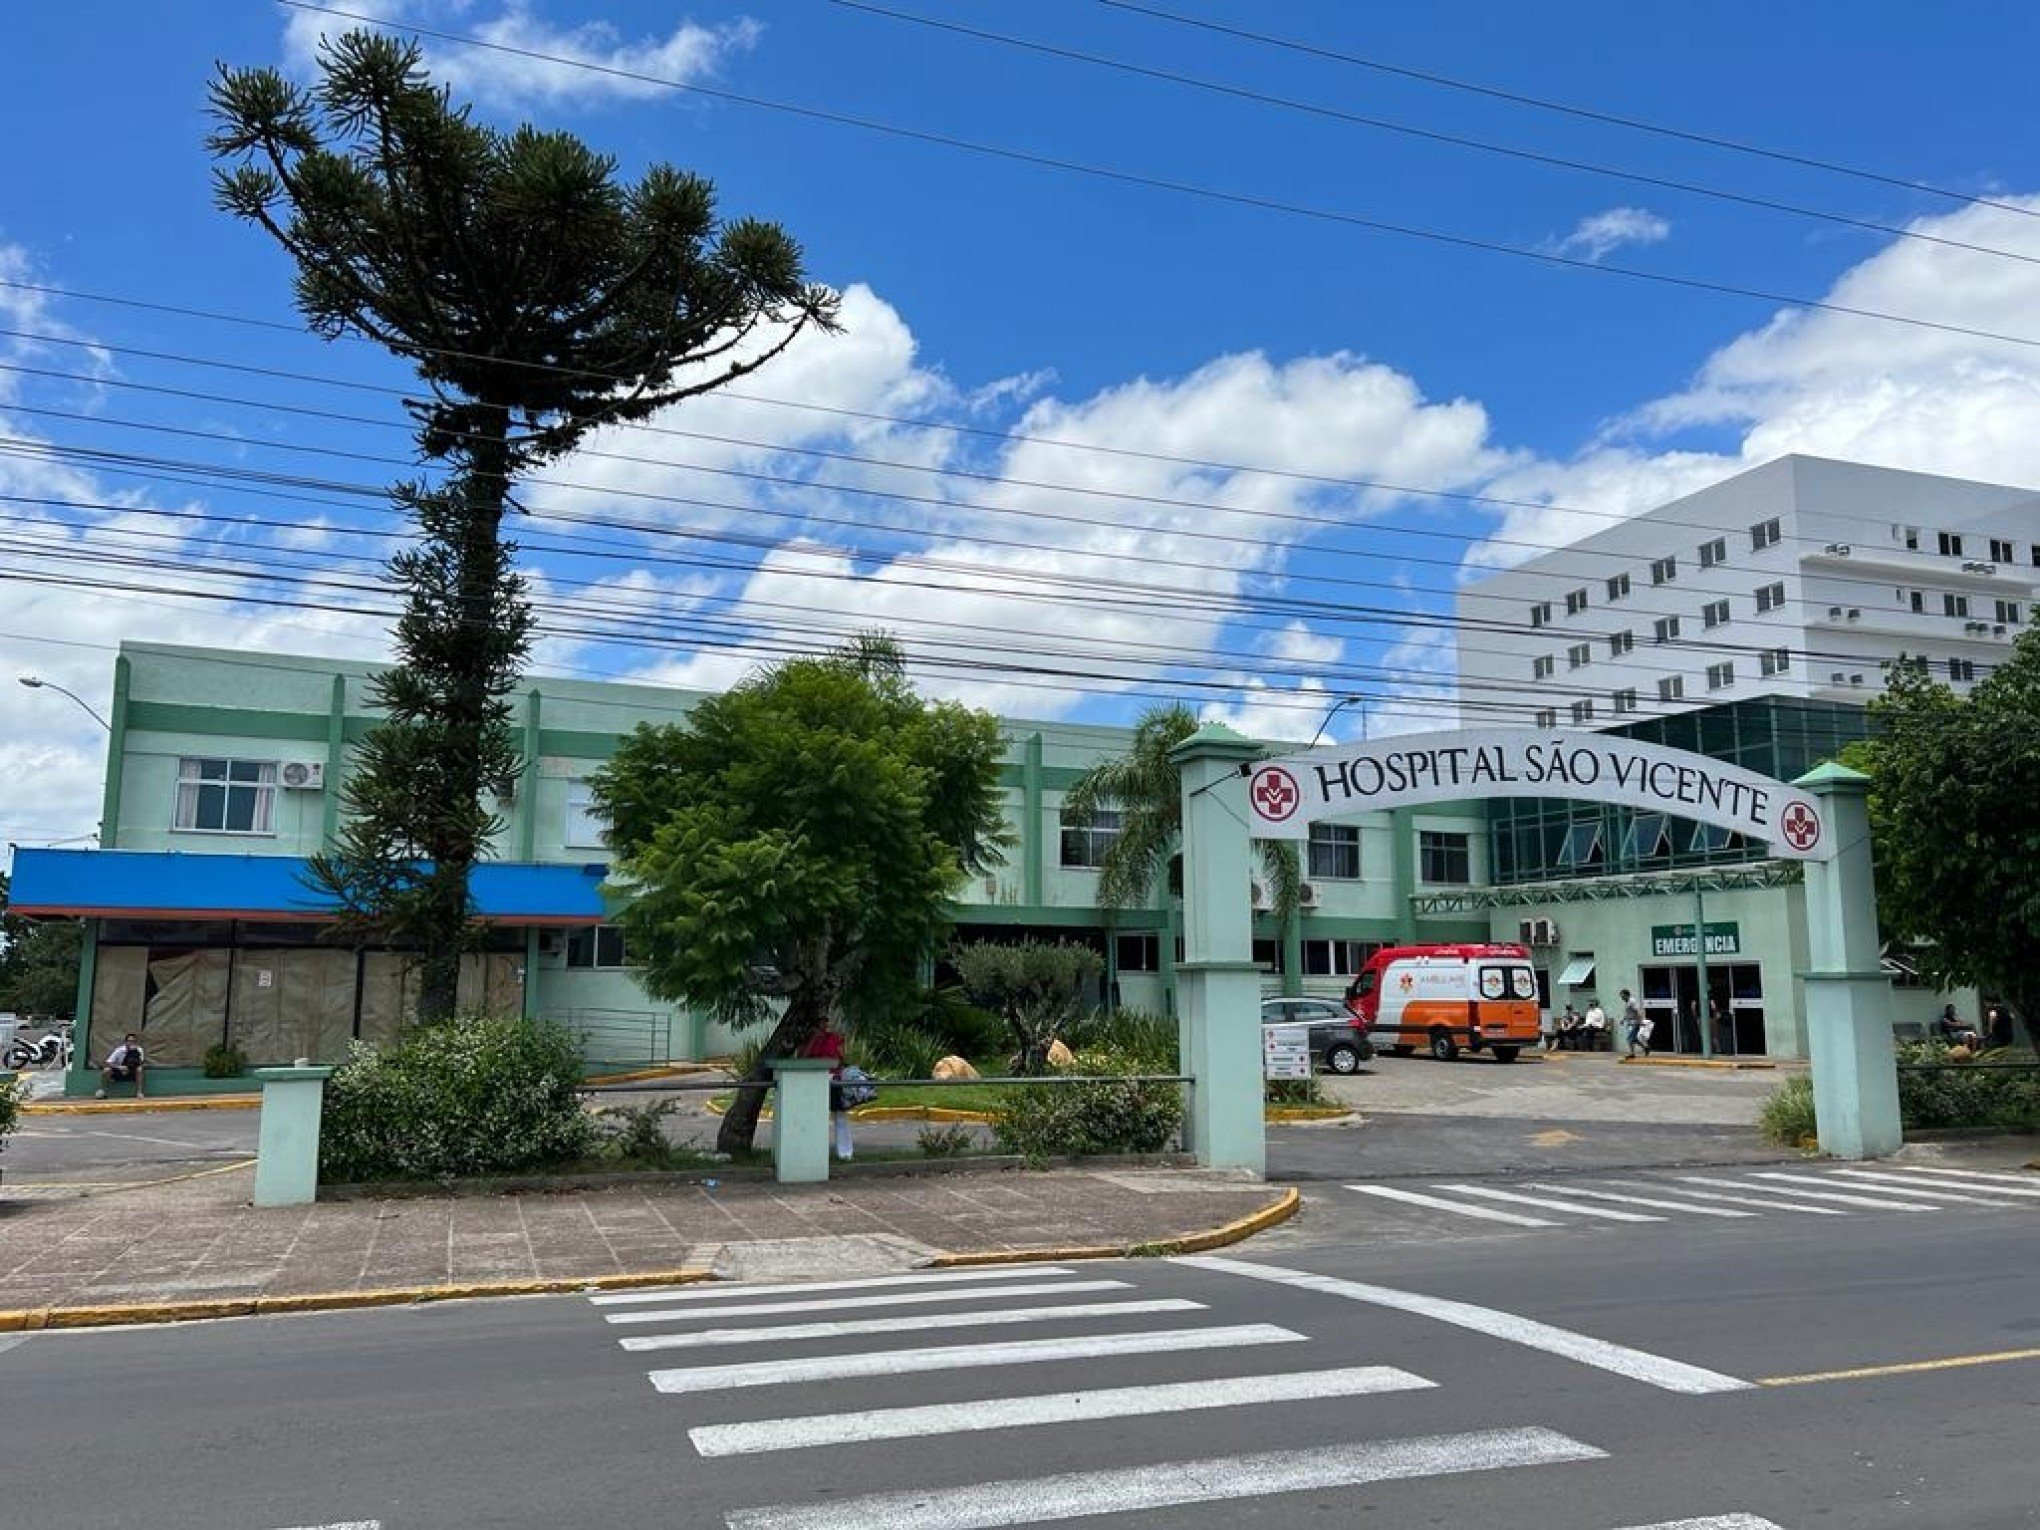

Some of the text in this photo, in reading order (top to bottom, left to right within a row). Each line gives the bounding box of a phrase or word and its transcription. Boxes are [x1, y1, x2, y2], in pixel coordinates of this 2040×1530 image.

[1313, 740, 1769, 825] HOSPITAL SÃO VICENTE
[1655, 935, 1736, 955] EMERGNCIA
